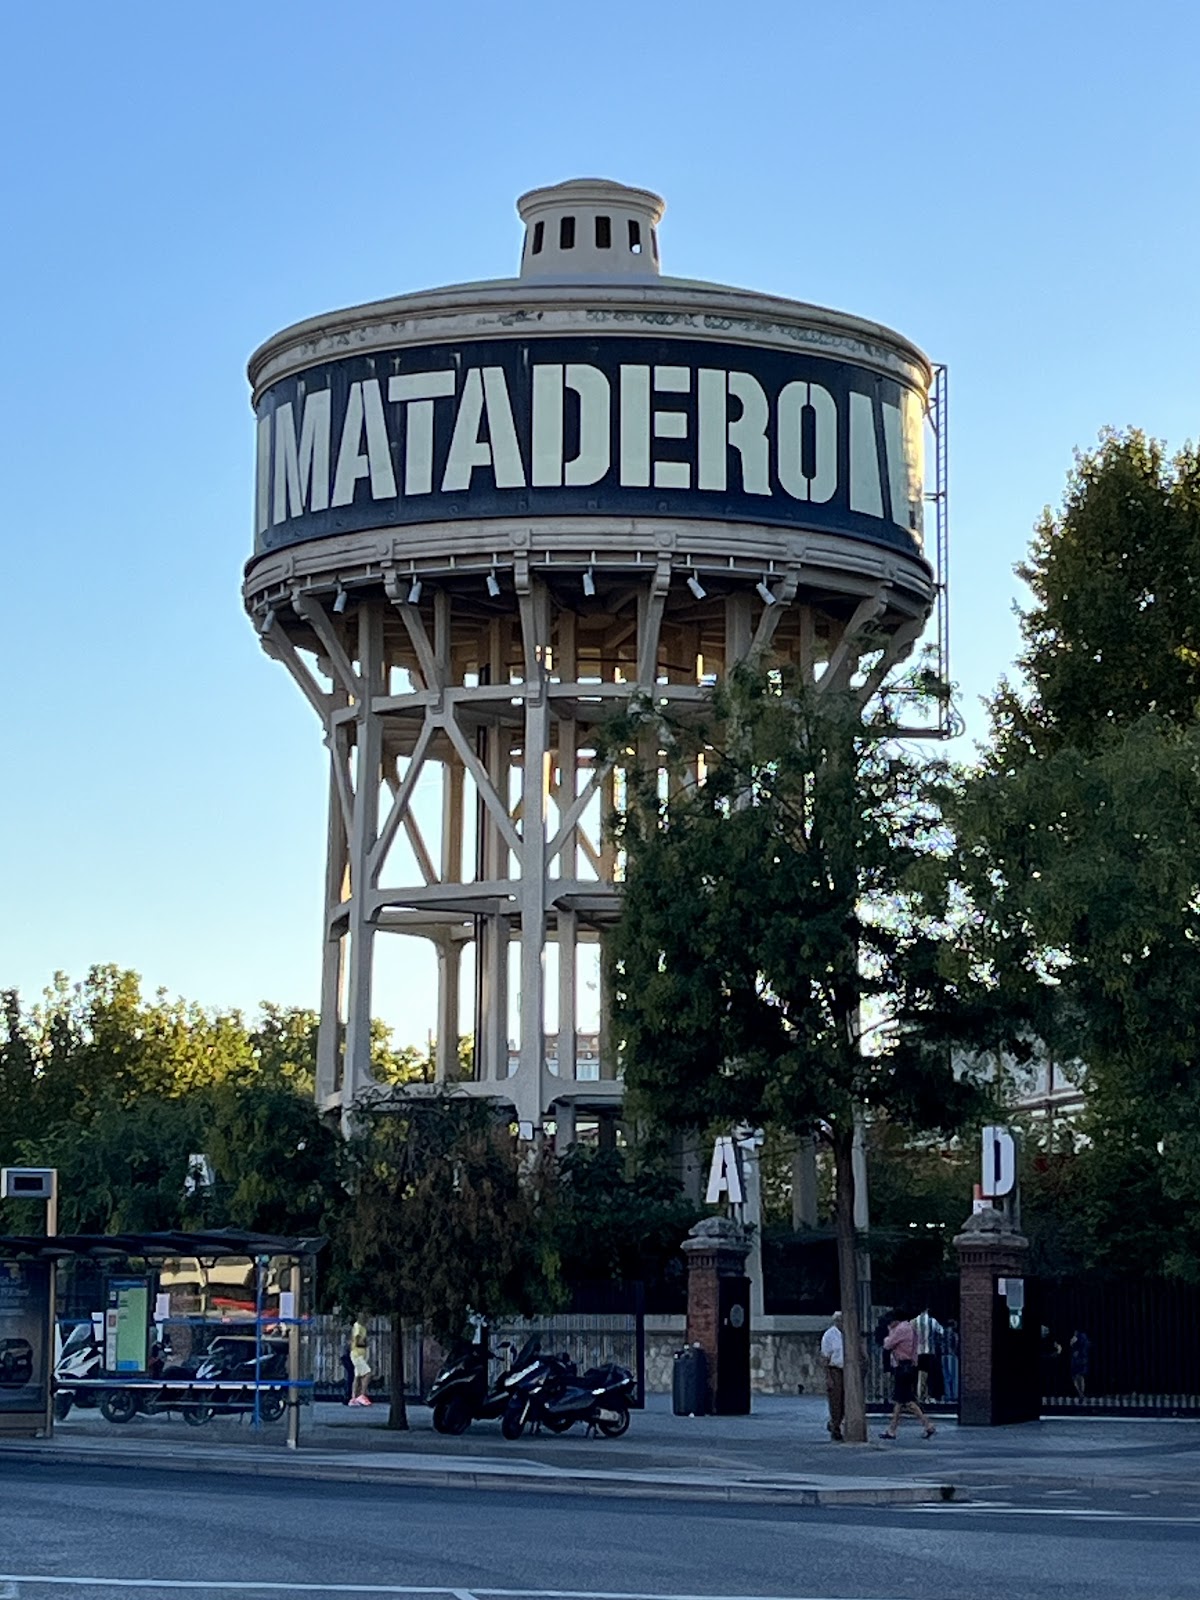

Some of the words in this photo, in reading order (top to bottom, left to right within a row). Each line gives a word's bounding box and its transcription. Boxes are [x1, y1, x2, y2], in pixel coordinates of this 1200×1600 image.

[273, 363, 838, 525] MATADERO
[706, 1136, 742, 1203] A
[982, 1126, 1015, 1196] D
